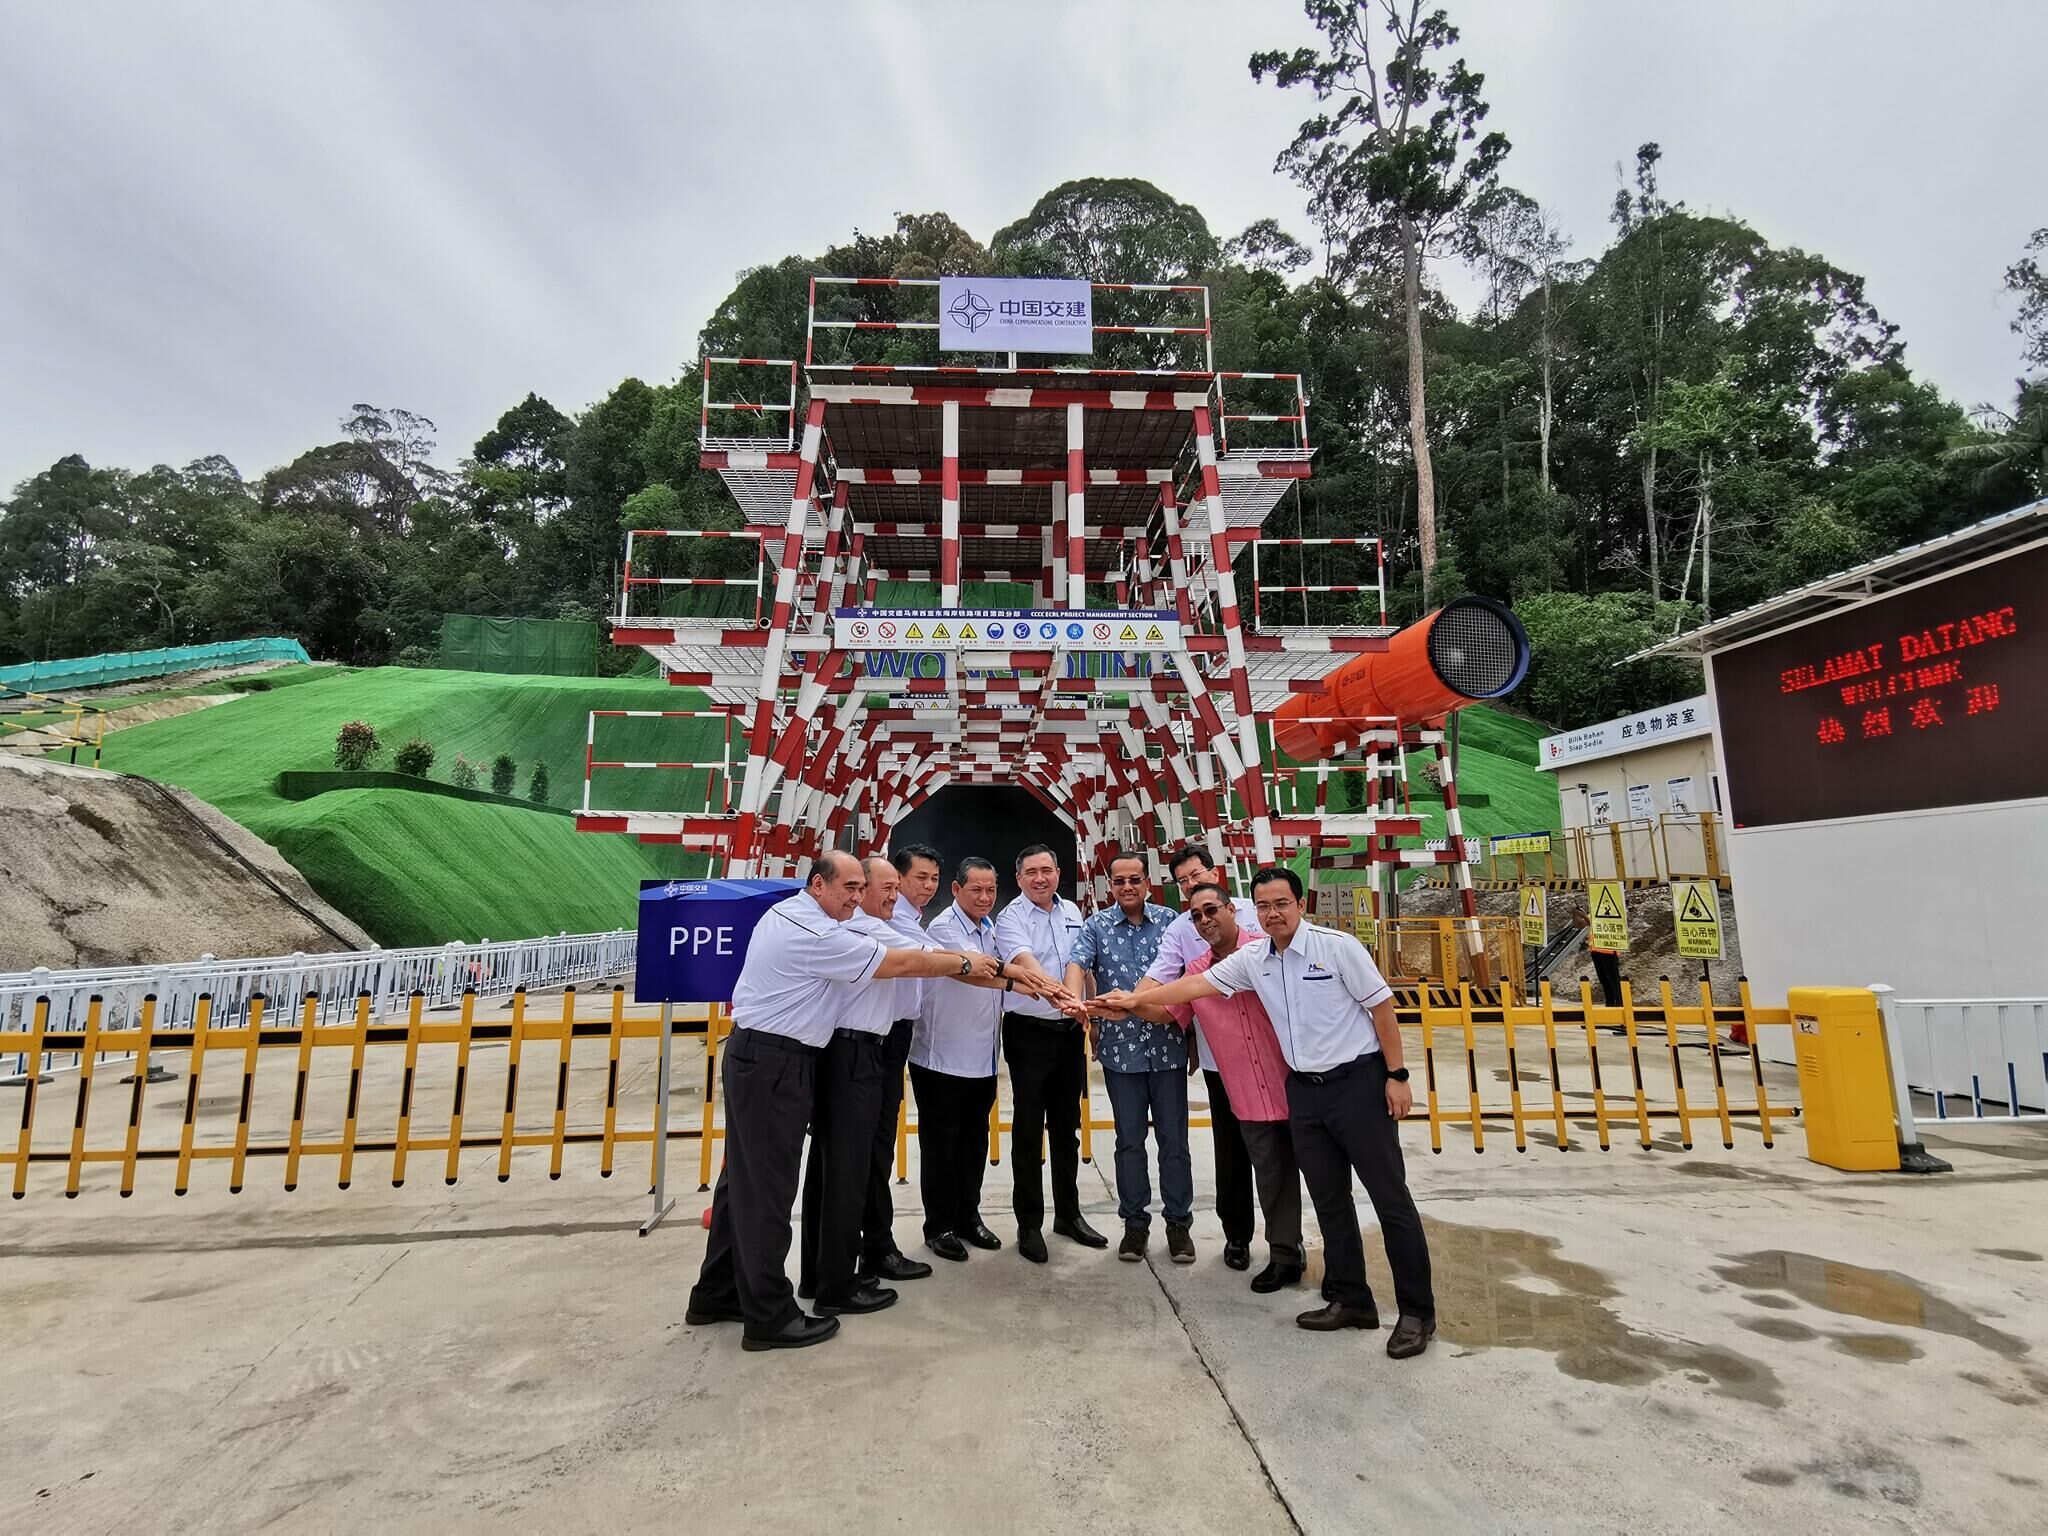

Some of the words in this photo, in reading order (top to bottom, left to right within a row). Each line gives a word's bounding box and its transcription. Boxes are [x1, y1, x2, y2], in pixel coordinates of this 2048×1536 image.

[1000, 299, 1086, 318] 中国交建
[1780, 643, 1884, 693] SELAMAT
[1621, 708, 1696, 738] 应急物资室
[1568, 735, 1583, 744] Bilik
[1583, 730, 1604, 741] Bahan
[1568, 743, 1583, 752] Siap
[1596, 922, 1624, 933] 当心落物
[1681, 926, 1717, 939] 当心吊物
[669, 926, 734, 956] PPE
[1687, 938, 1712, 946] WARNING
[1680, 946, 1707, 954] OVERHEAD
